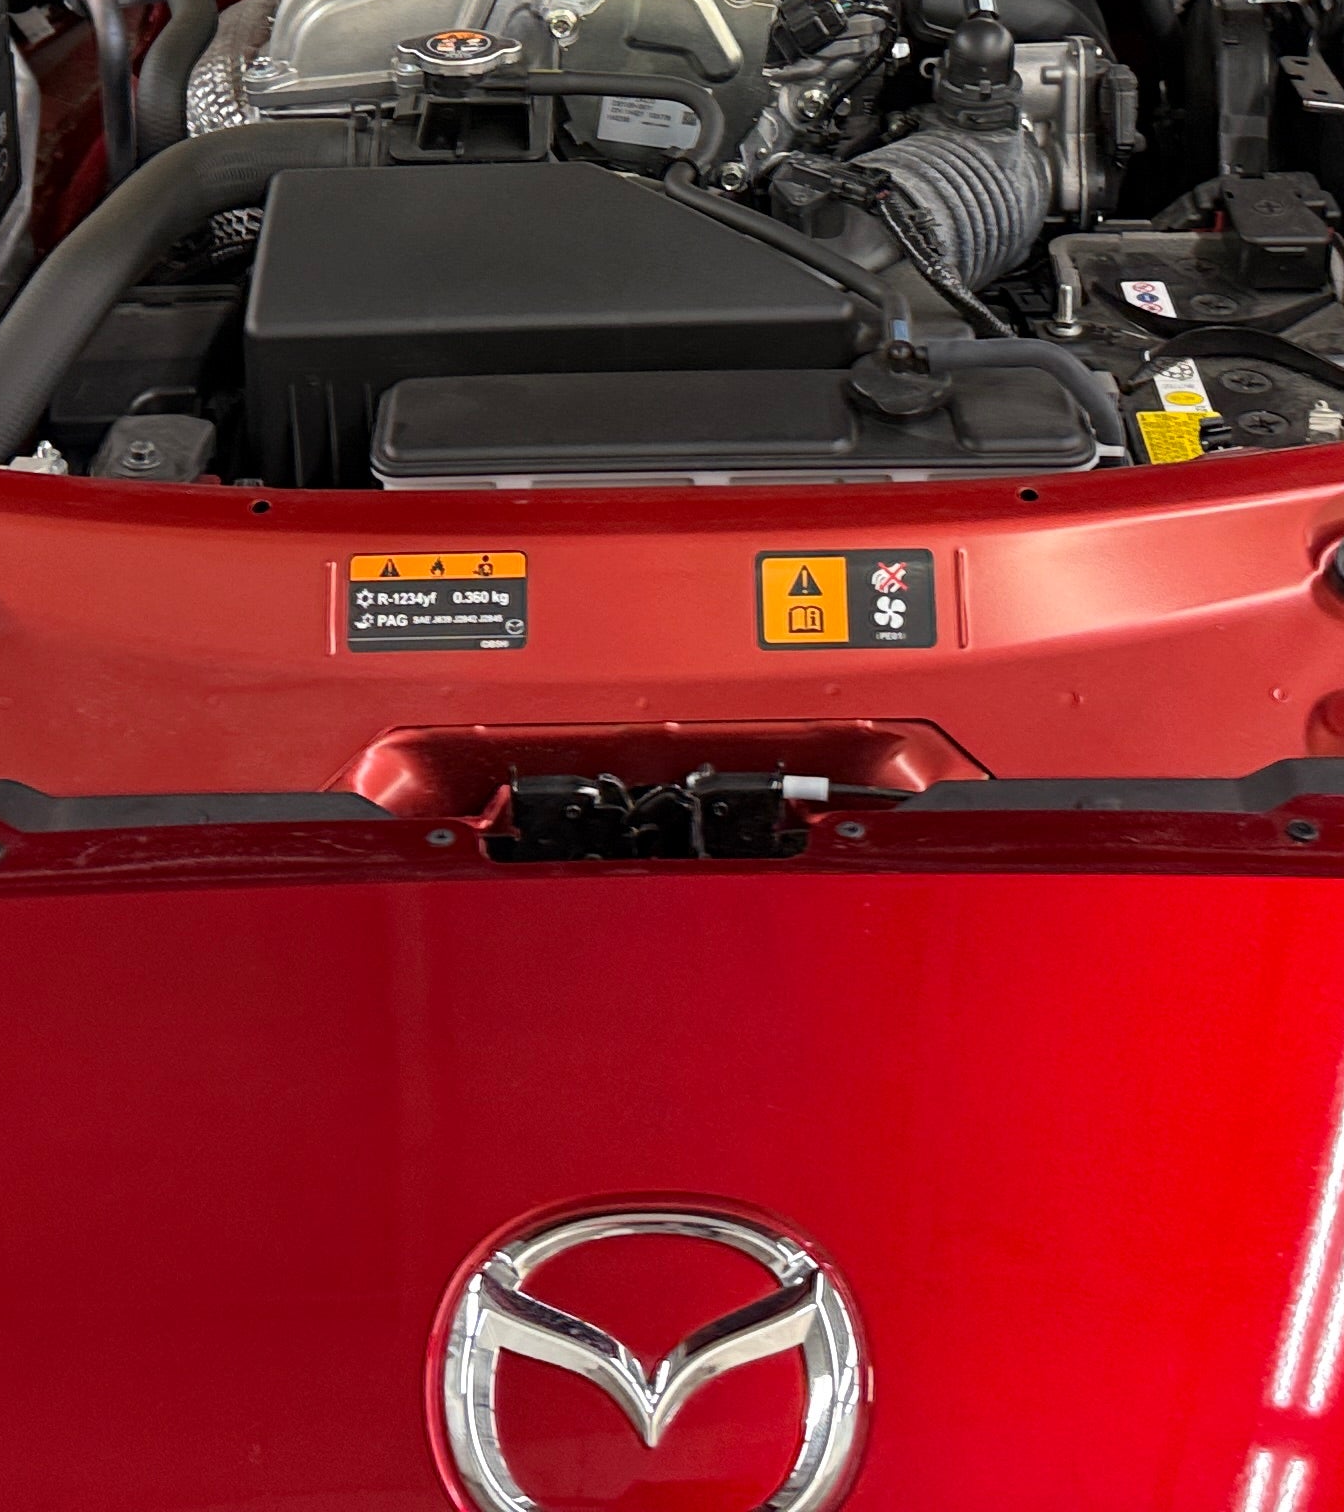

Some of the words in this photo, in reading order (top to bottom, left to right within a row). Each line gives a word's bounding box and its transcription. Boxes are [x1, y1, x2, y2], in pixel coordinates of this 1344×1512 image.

[377, 592, 437, 607] R-1234yf
[492, 591, 510, 606] kg
[377, 614, 408, 627] PAG
